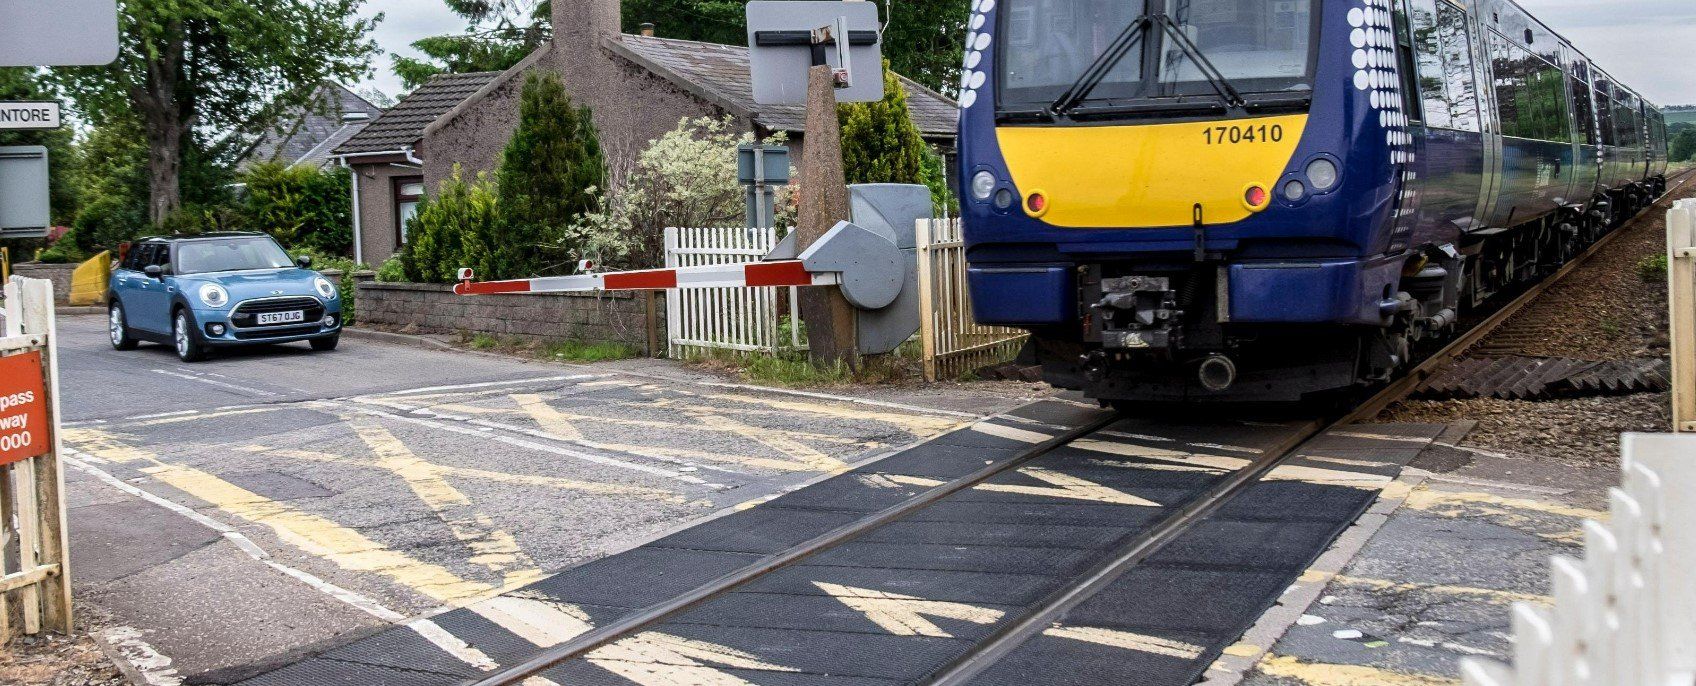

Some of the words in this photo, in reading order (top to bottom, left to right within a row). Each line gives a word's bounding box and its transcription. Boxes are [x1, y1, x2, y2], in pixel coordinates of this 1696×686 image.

[1202, 124, 1283, 145] 170410
[261, 312, 283, 323] ST67
[0, 390, 35, 412] pass
[0, 413, 28, 430] way
[0, 431, 32, 452] 000
